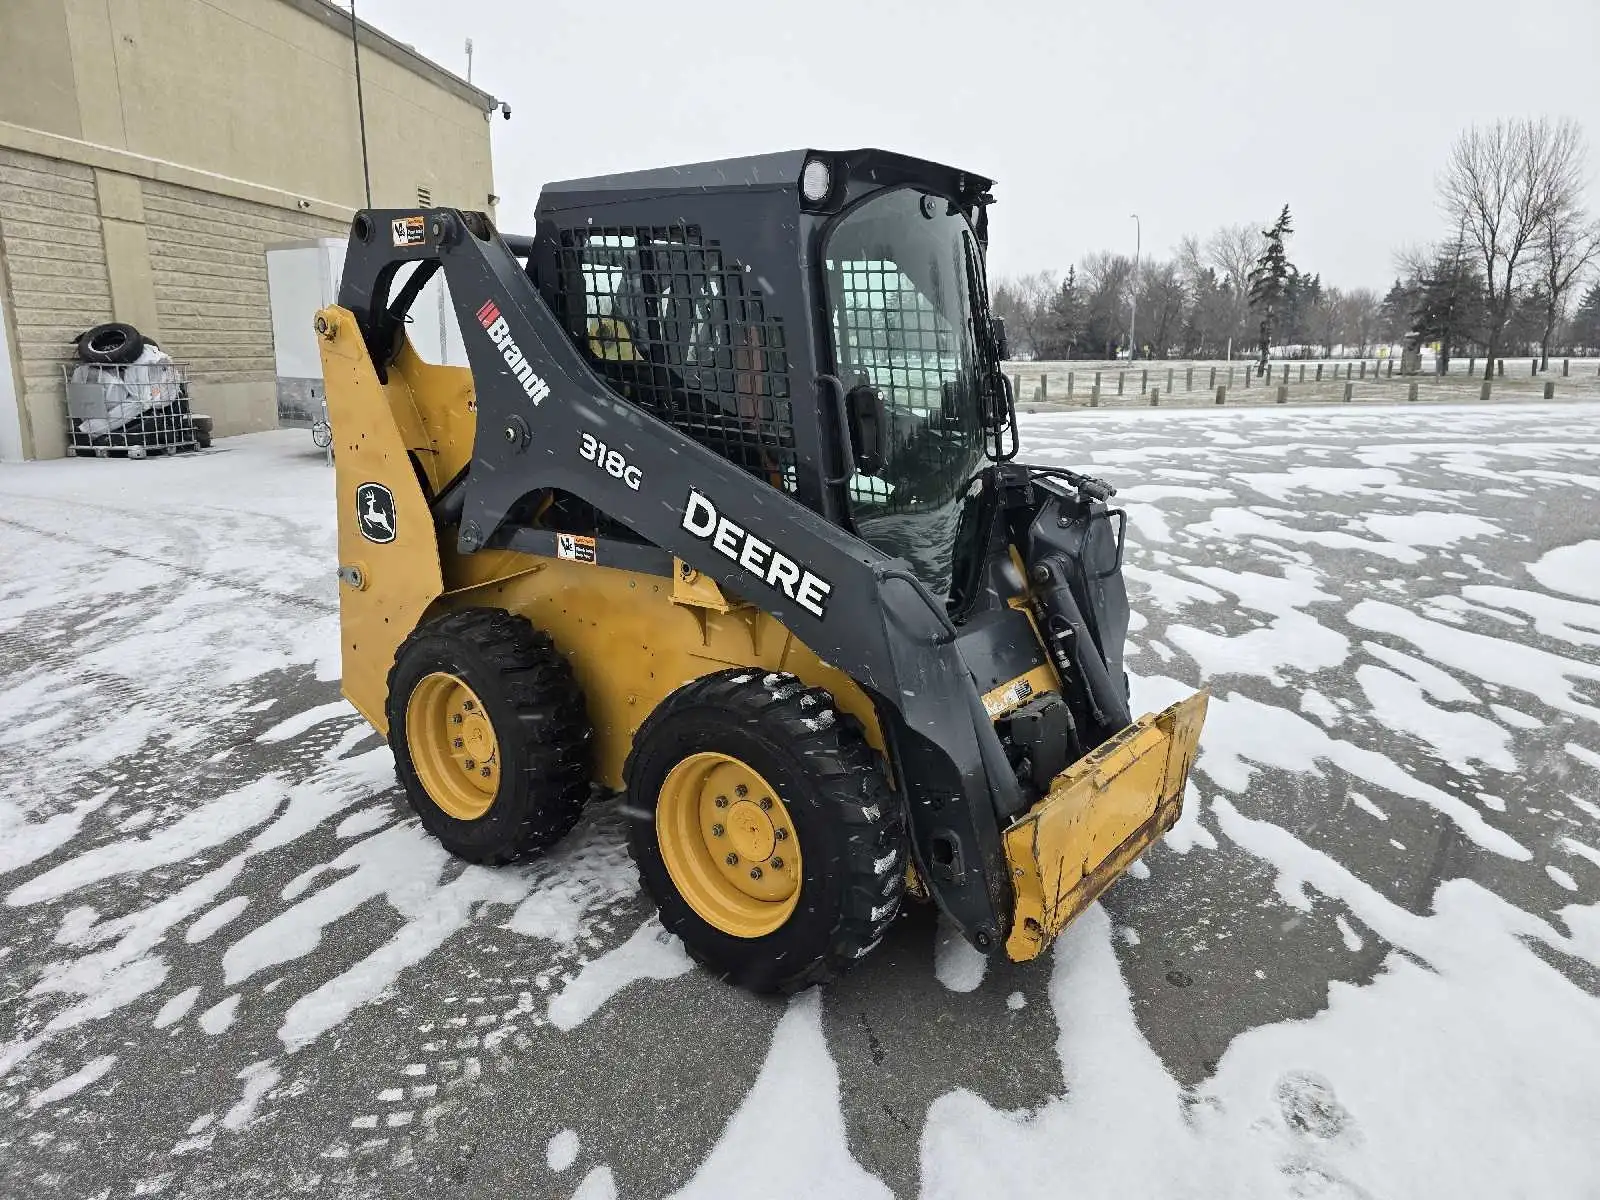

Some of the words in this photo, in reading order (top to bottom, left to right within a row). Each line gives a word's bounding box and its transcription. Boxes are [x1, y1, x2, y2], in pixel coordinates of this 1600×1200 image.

[486, 315, 551, 407] Brandt
[579, 432, 643, 491] 318G
[682, 489, 831, 617] DEERE
